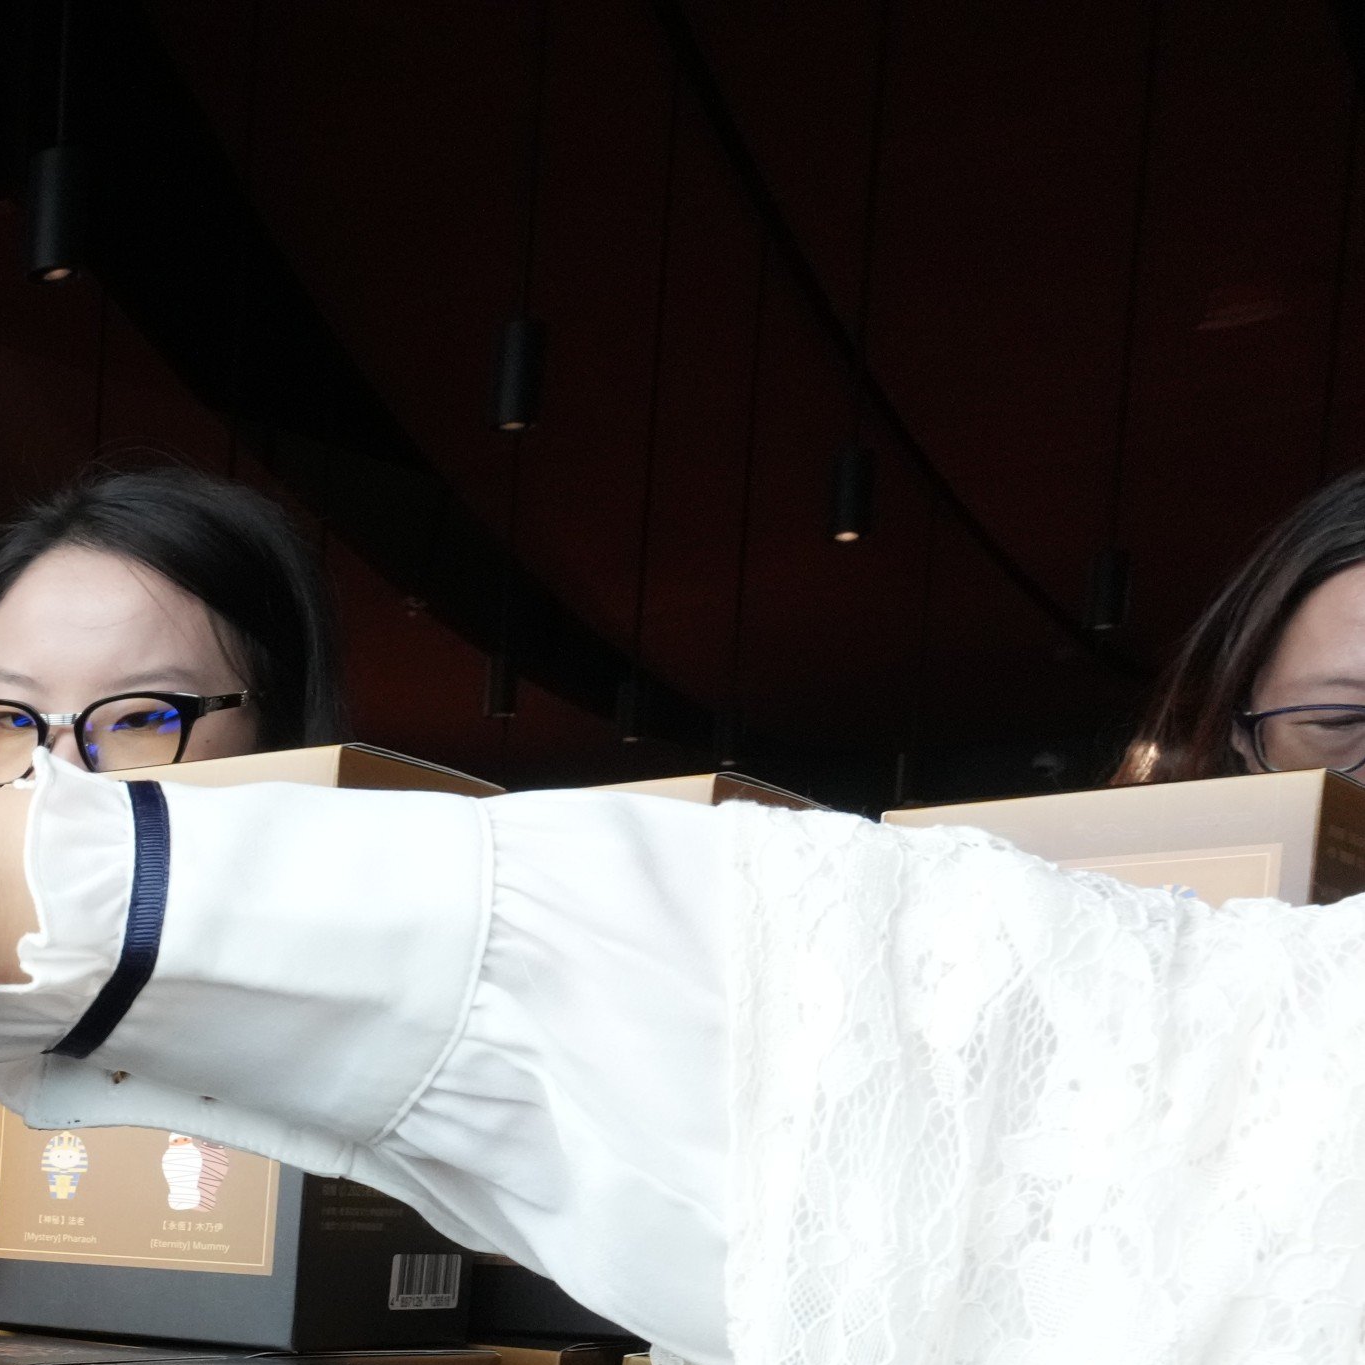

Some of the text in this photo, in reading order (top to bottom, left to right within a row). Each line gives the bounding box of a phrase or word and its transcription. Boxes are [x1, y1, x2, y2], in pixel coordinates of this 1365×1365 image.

[24, 1231, 97, 1244] [Mystery] Pharaoh
[150, 1238, 230, 1254] [Eternity] Mummy
